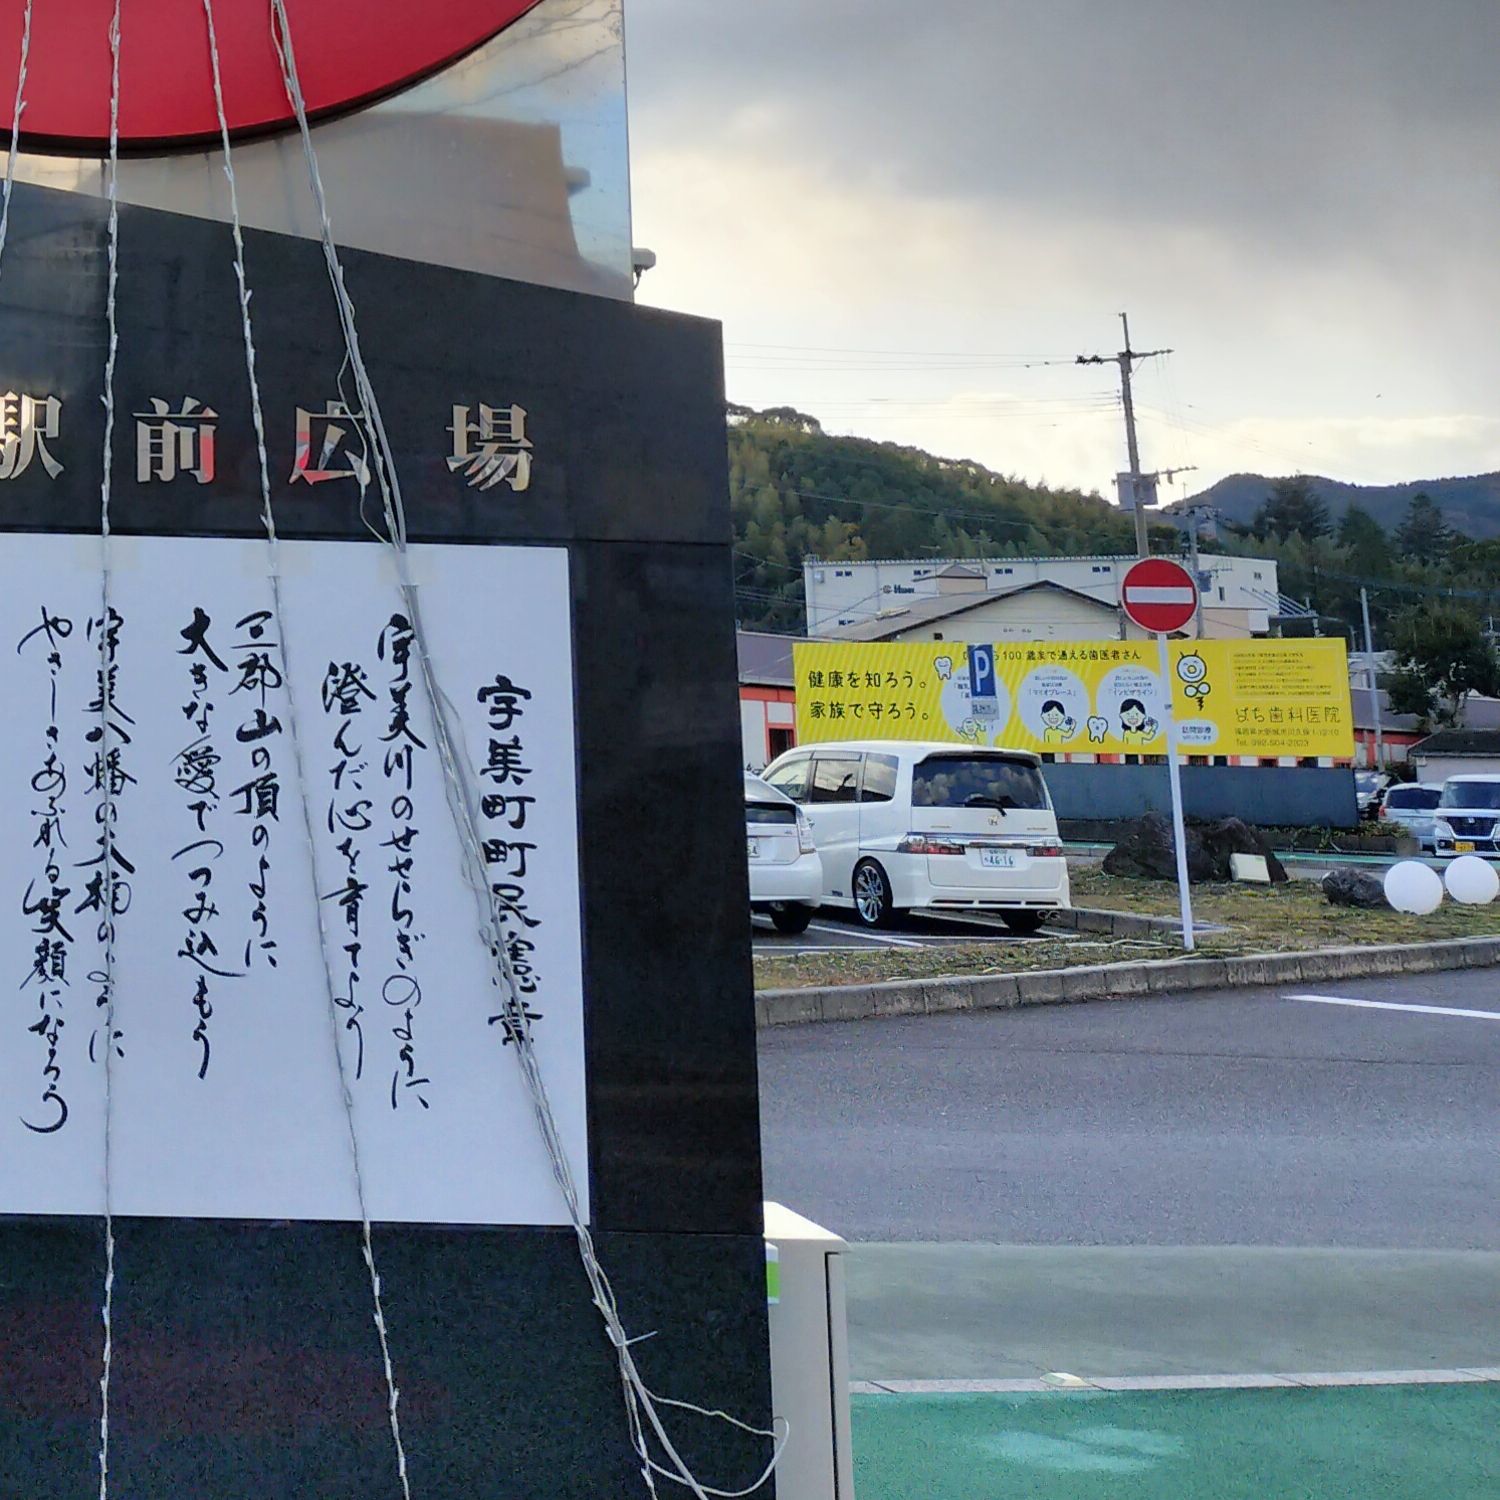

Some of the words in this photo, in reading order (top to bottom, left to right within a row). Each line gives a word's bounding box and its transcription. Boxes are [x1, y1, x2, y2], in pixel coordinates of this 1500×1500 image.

[808, 670, 927, 689] 健康を知ろう。
[975, 649, 991, 693] P
[810, 701, 930, 720] 家族で守ろう。
[230, 610, 282, 968] 三郡山の頂のように
[17, 605, 75, 1133] やさしさあふれる笑顔になろう
